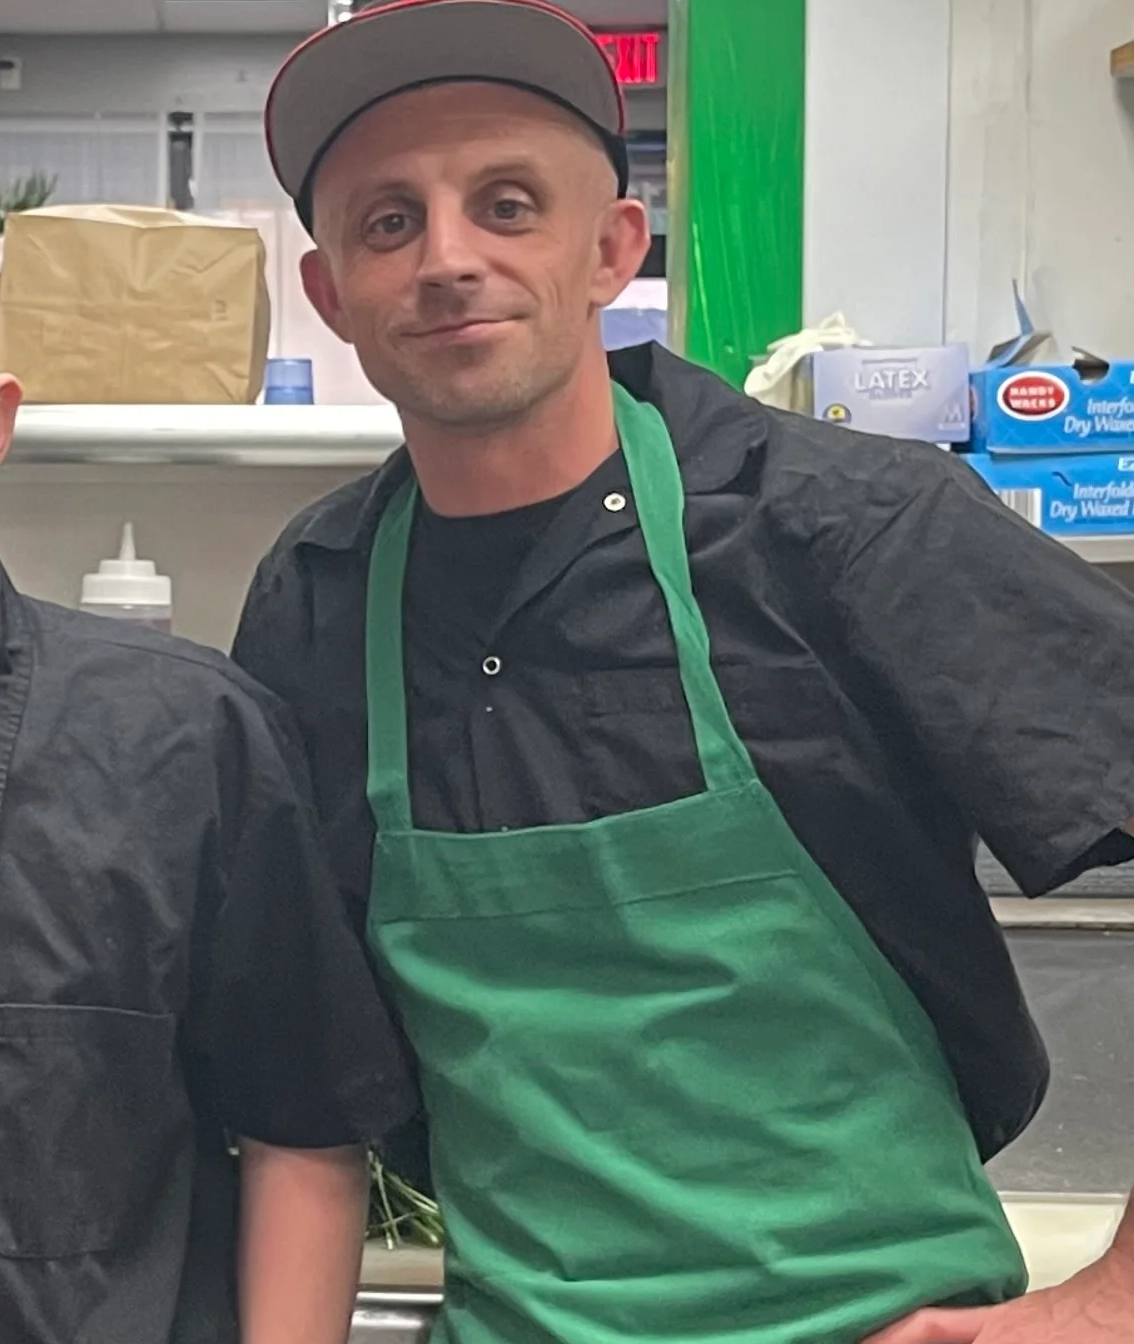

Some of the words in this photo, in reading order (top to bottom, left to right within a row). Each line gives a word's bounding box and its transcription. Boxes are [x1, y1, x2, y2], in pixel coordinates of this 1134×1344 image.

[854, 369, 929, 392] LATEX
[1064, 416, 1091, 438] Dry
[1050, 500, 1078, 523] Dry
[1081, 500, 1130, 518] Waxed
